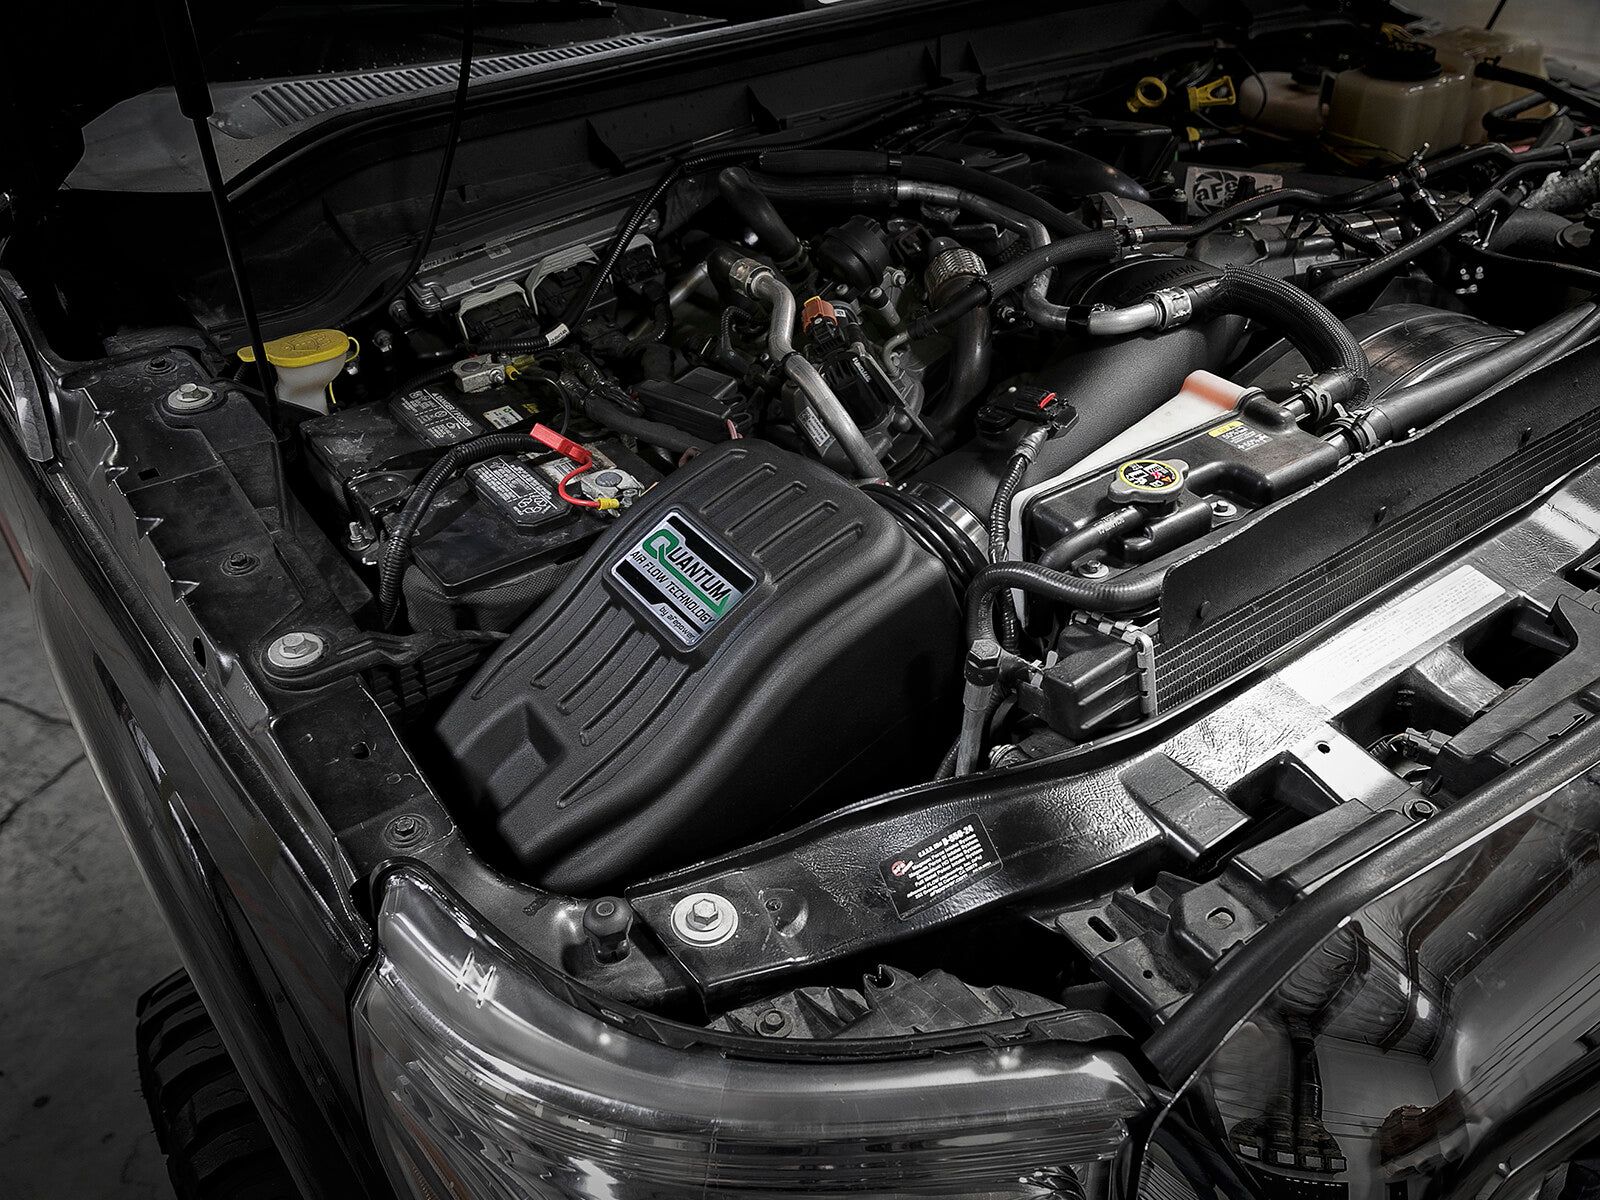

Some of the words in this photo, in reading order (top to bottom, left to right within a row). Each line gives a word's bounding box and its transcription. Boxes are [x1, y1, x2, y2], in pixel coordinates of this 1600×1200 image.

[630, 551, 644, 565] AIR
[642, 560, 669, 584] FLOW
[665, 581, 716, 626] TECHNOLOGY
[642, 529, 732, 602] QUANTUM
[658, 606, 668, 616] by
